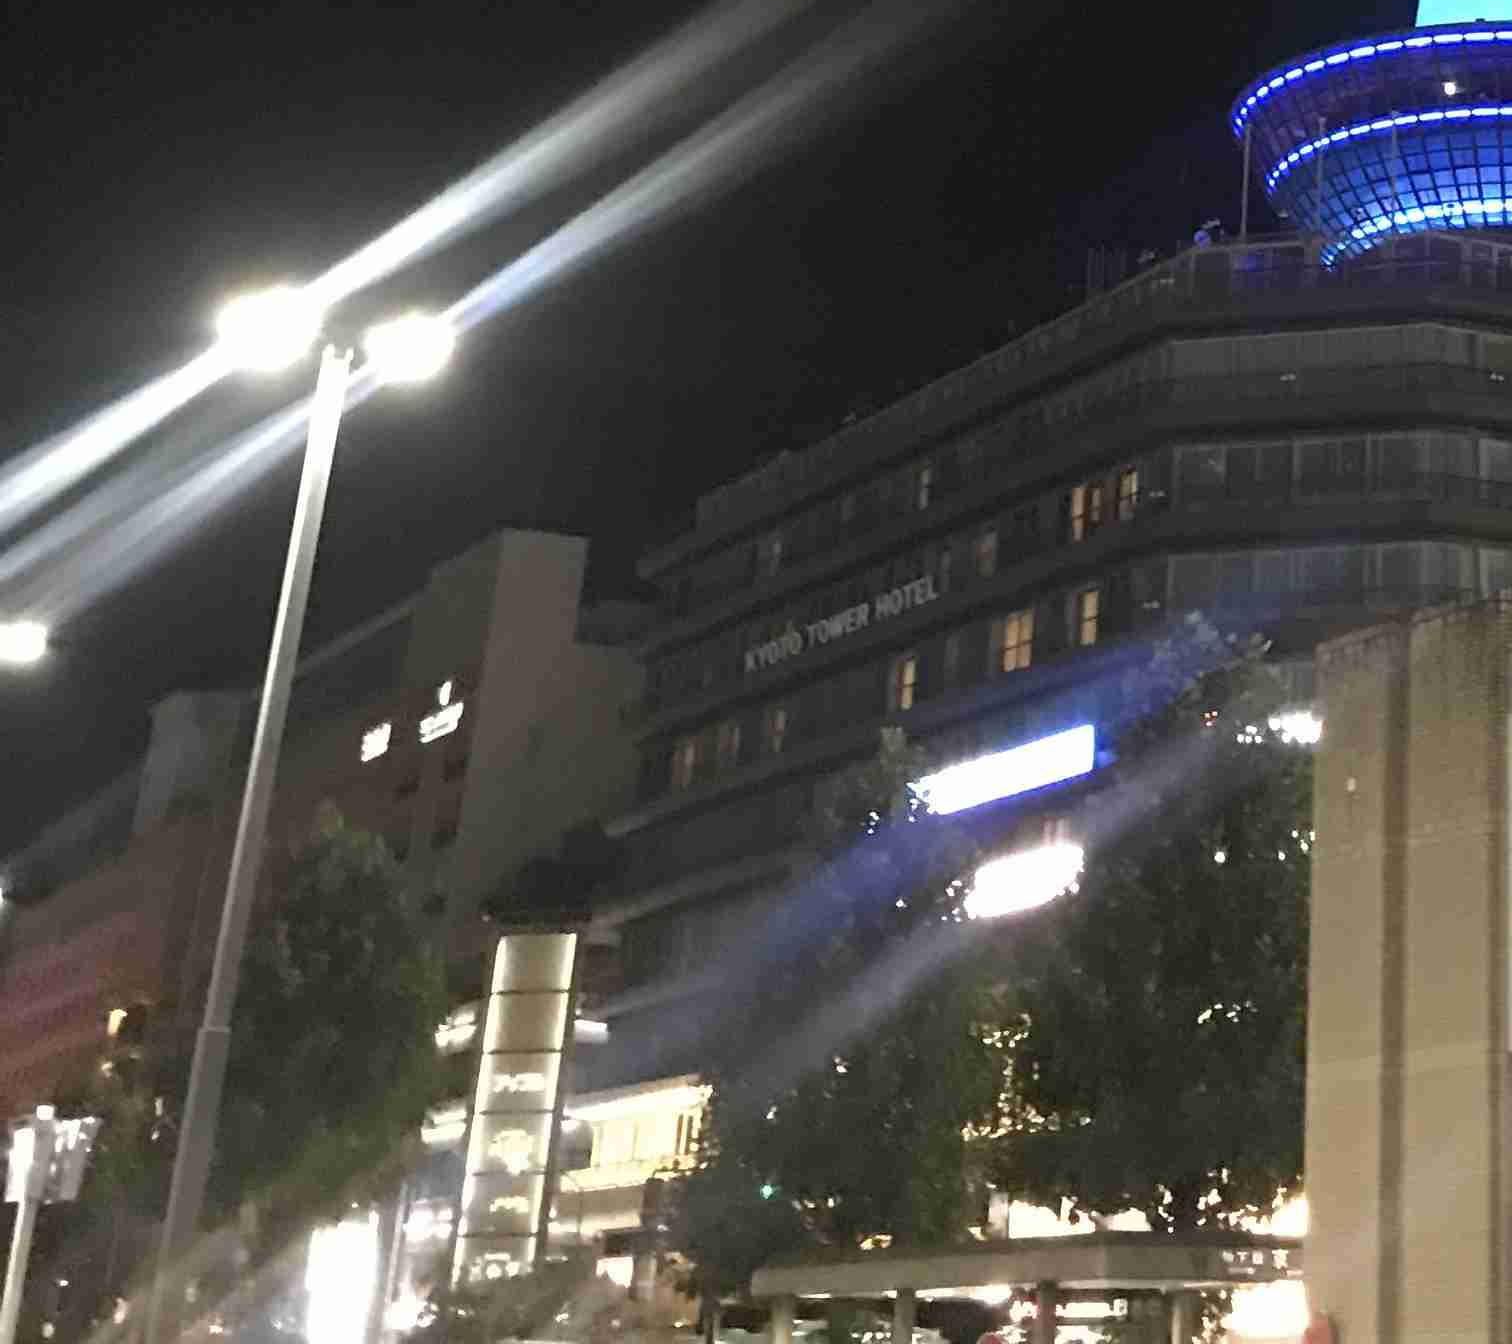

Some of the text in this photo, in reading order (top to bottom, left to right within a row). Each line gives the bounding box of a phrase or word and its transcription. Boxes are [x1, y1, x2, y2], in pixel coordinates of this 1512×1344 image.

[744, 576, 938, 672] KYOTO TOWER HOTEL
